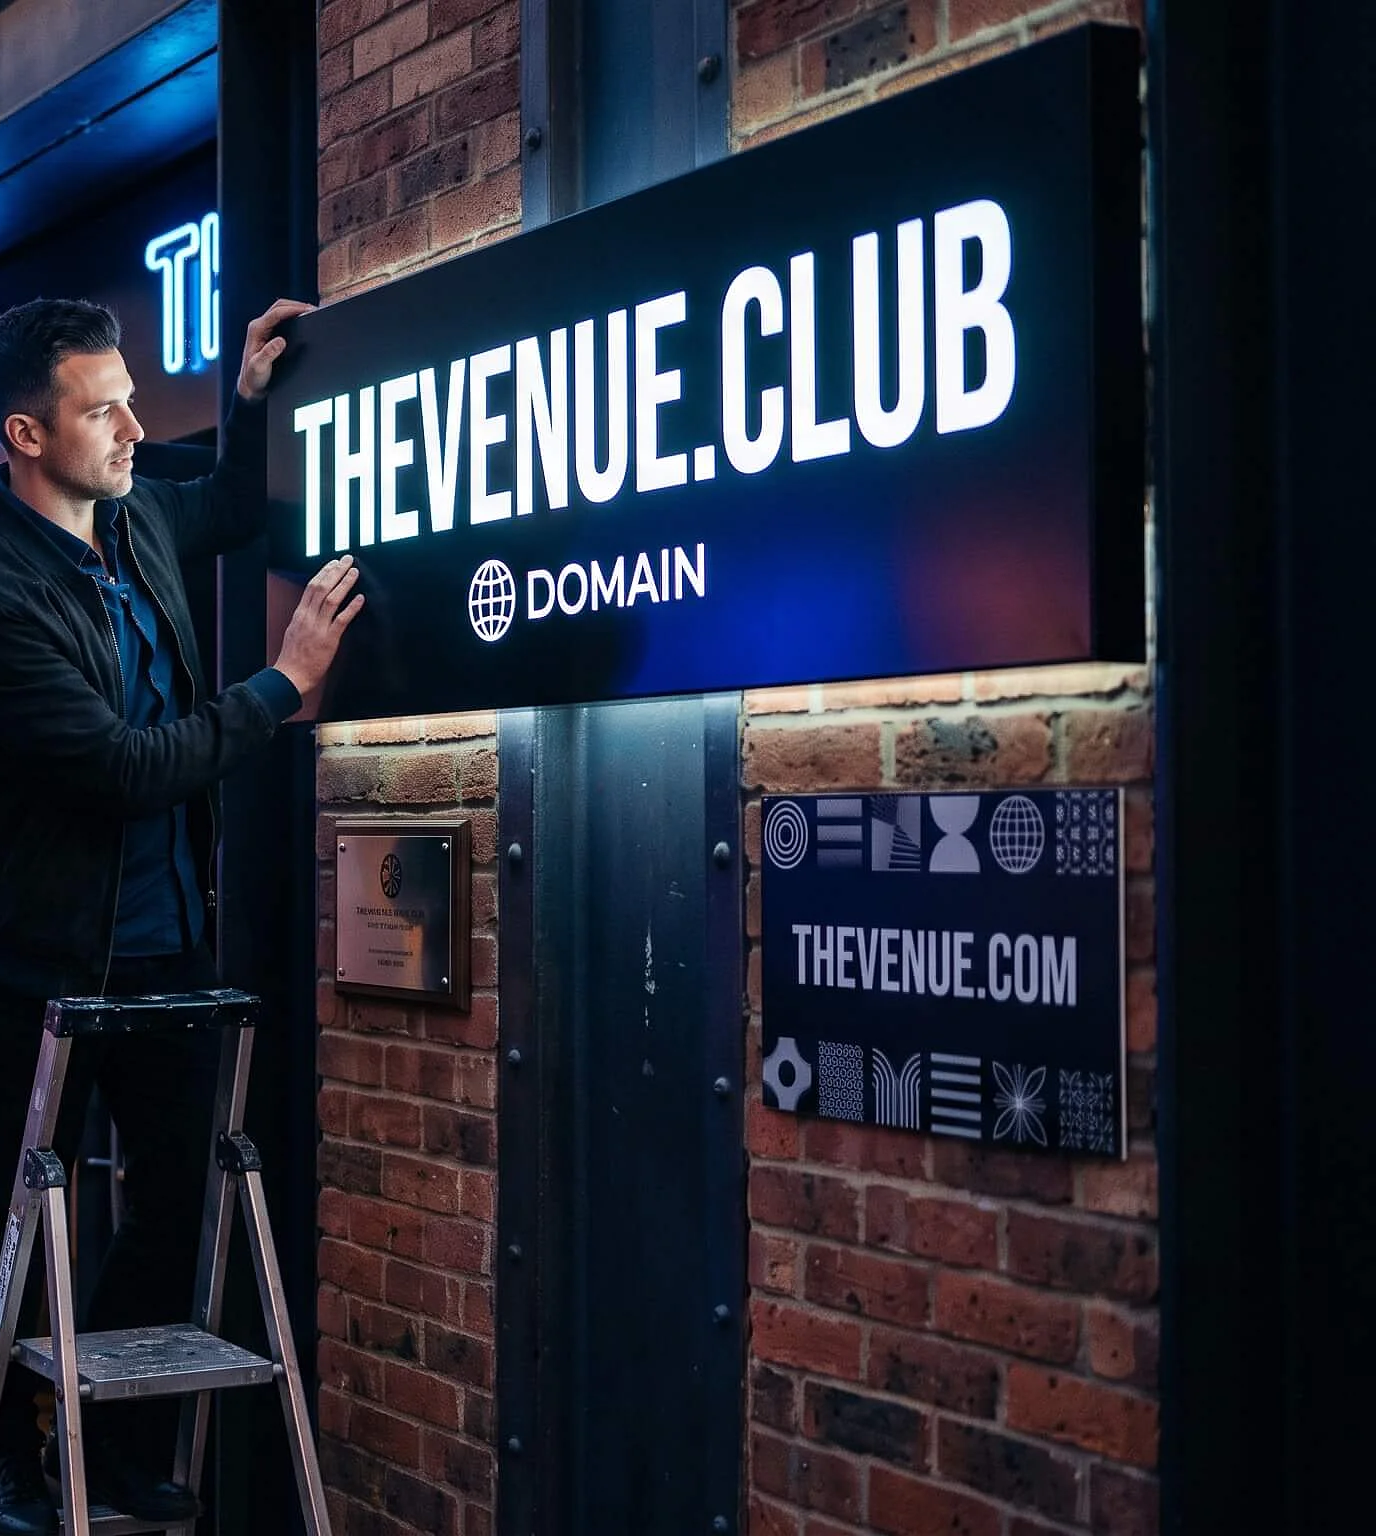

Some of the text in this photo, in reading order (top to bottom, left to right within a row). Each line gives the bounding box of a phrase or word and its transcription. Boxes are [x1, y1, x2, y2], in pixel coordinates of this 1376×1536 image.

[294, 199, 1016, 557] THEVENUE.CLUB
[527, 542, 706, 620] DOMAIN
[791, 924, 1077, 1007] THEVENUE.COM
